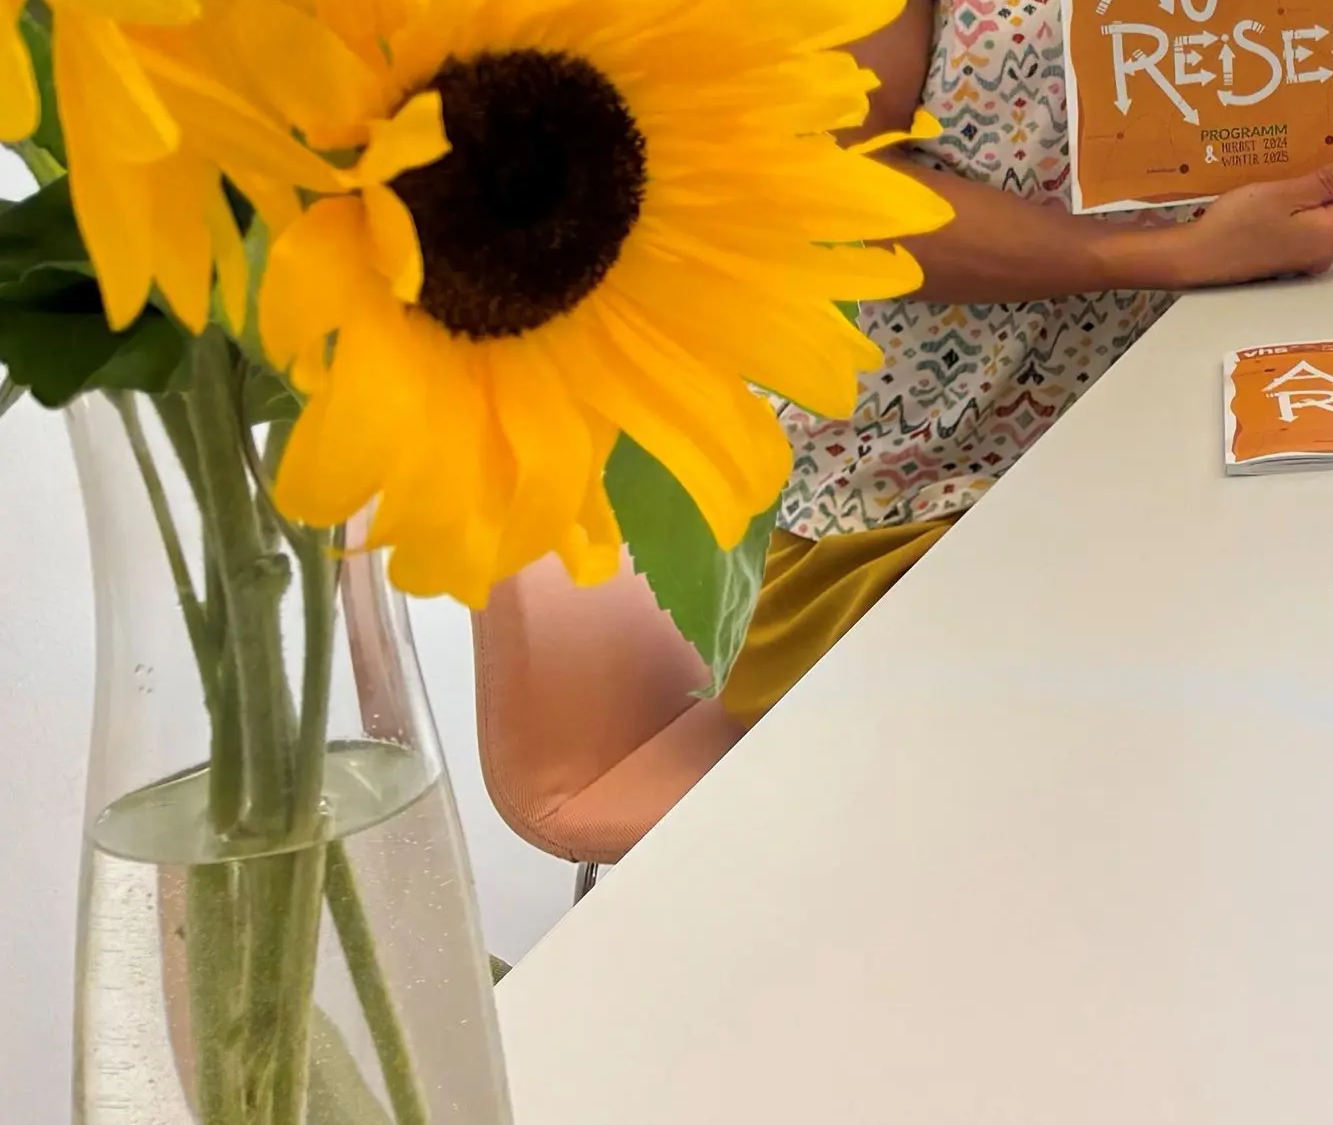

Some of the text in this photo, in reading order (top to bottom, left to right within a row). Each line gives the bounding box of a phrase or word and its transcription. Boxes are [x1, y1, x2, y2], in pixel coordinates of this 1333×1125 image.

[1201, 125, 1288, 142] PROGRAMM
[1263, 137, 1288, 150] 2024
[1204, 145, 1218, 164] &
[1263, 151, 1289, 164] 2025
